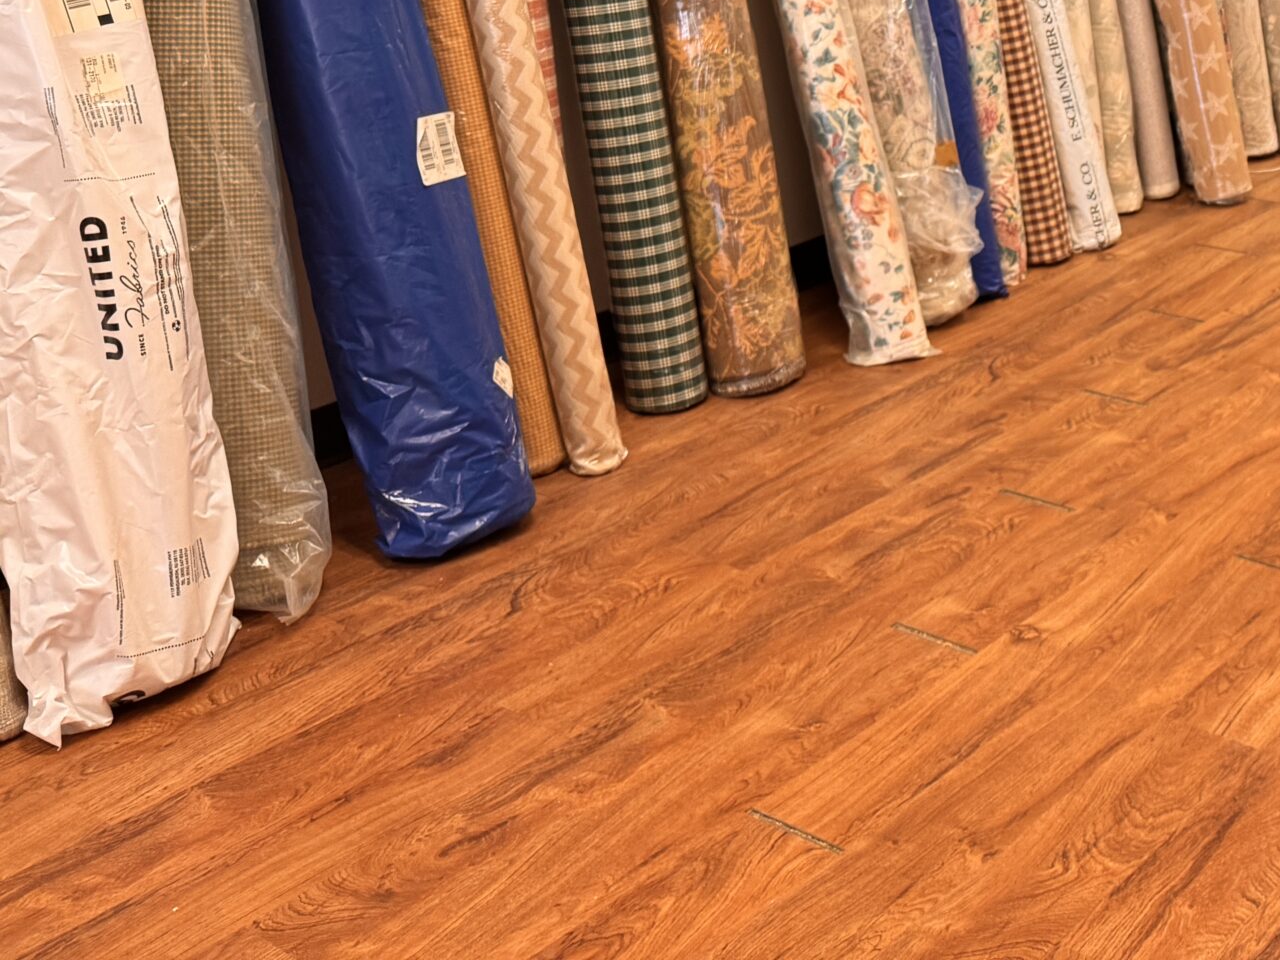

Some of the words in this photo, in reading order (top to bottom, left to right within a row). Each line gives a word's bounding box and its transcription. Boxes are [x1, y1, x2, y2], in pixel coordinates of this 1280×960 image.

[1042, 13, 1053, 24] &
[1046, 26, 1079, 128] SCHUMACHER
[1086, 188, 1097, 201] &
[80, 216, 123, 360] UNITED
[120, 240, 150, 328] Fabrics
